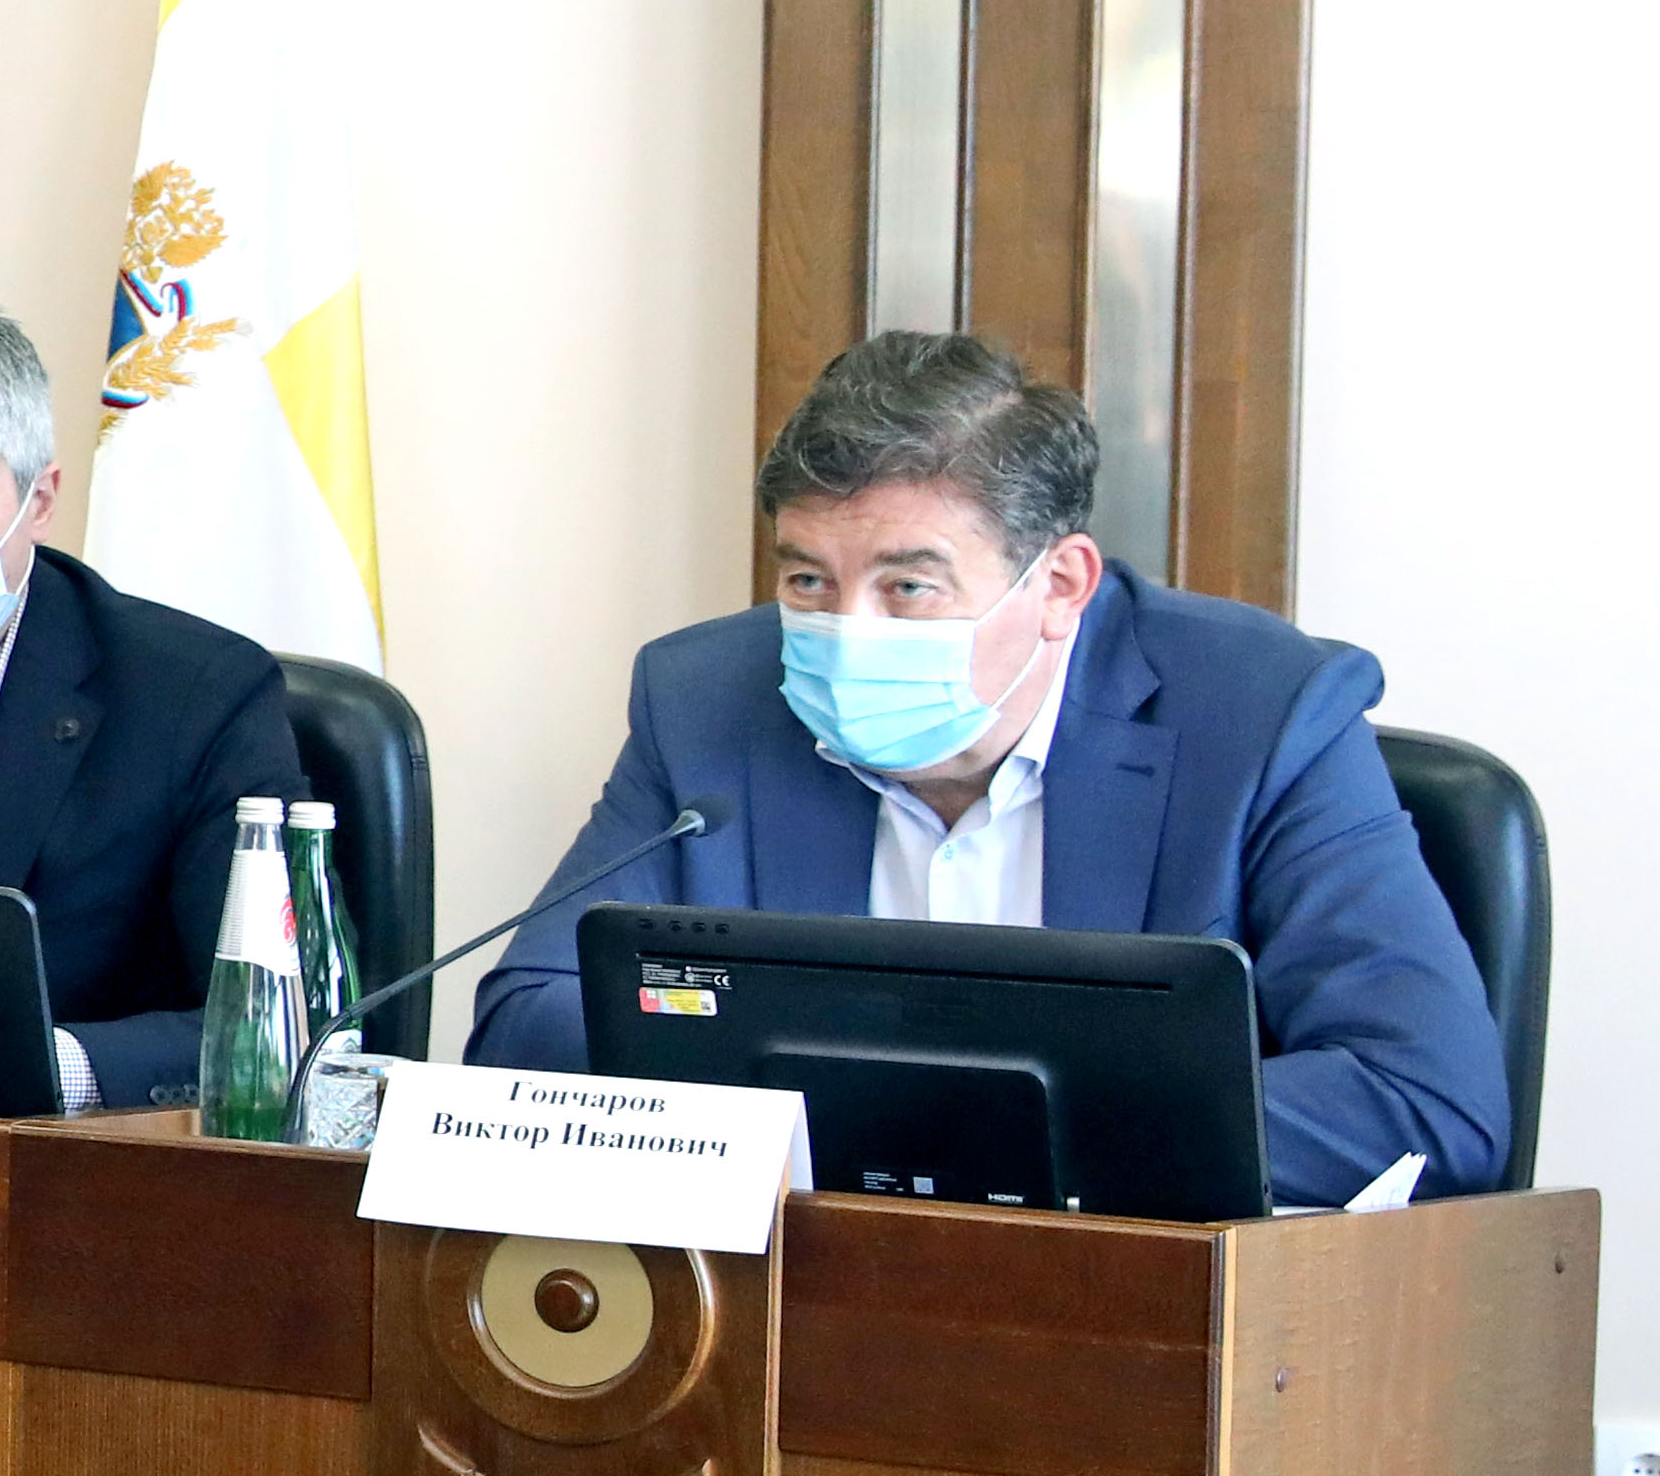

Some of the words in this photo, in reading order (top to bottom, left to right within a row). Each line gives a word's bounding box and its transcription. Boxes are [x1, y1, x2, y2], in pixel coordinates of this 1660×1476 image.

[508, 1079, 666, 1115] Гончаров
[431, 1112, 550, 1150] Виктор
[561, 1122, 728, 1158] Иванович
